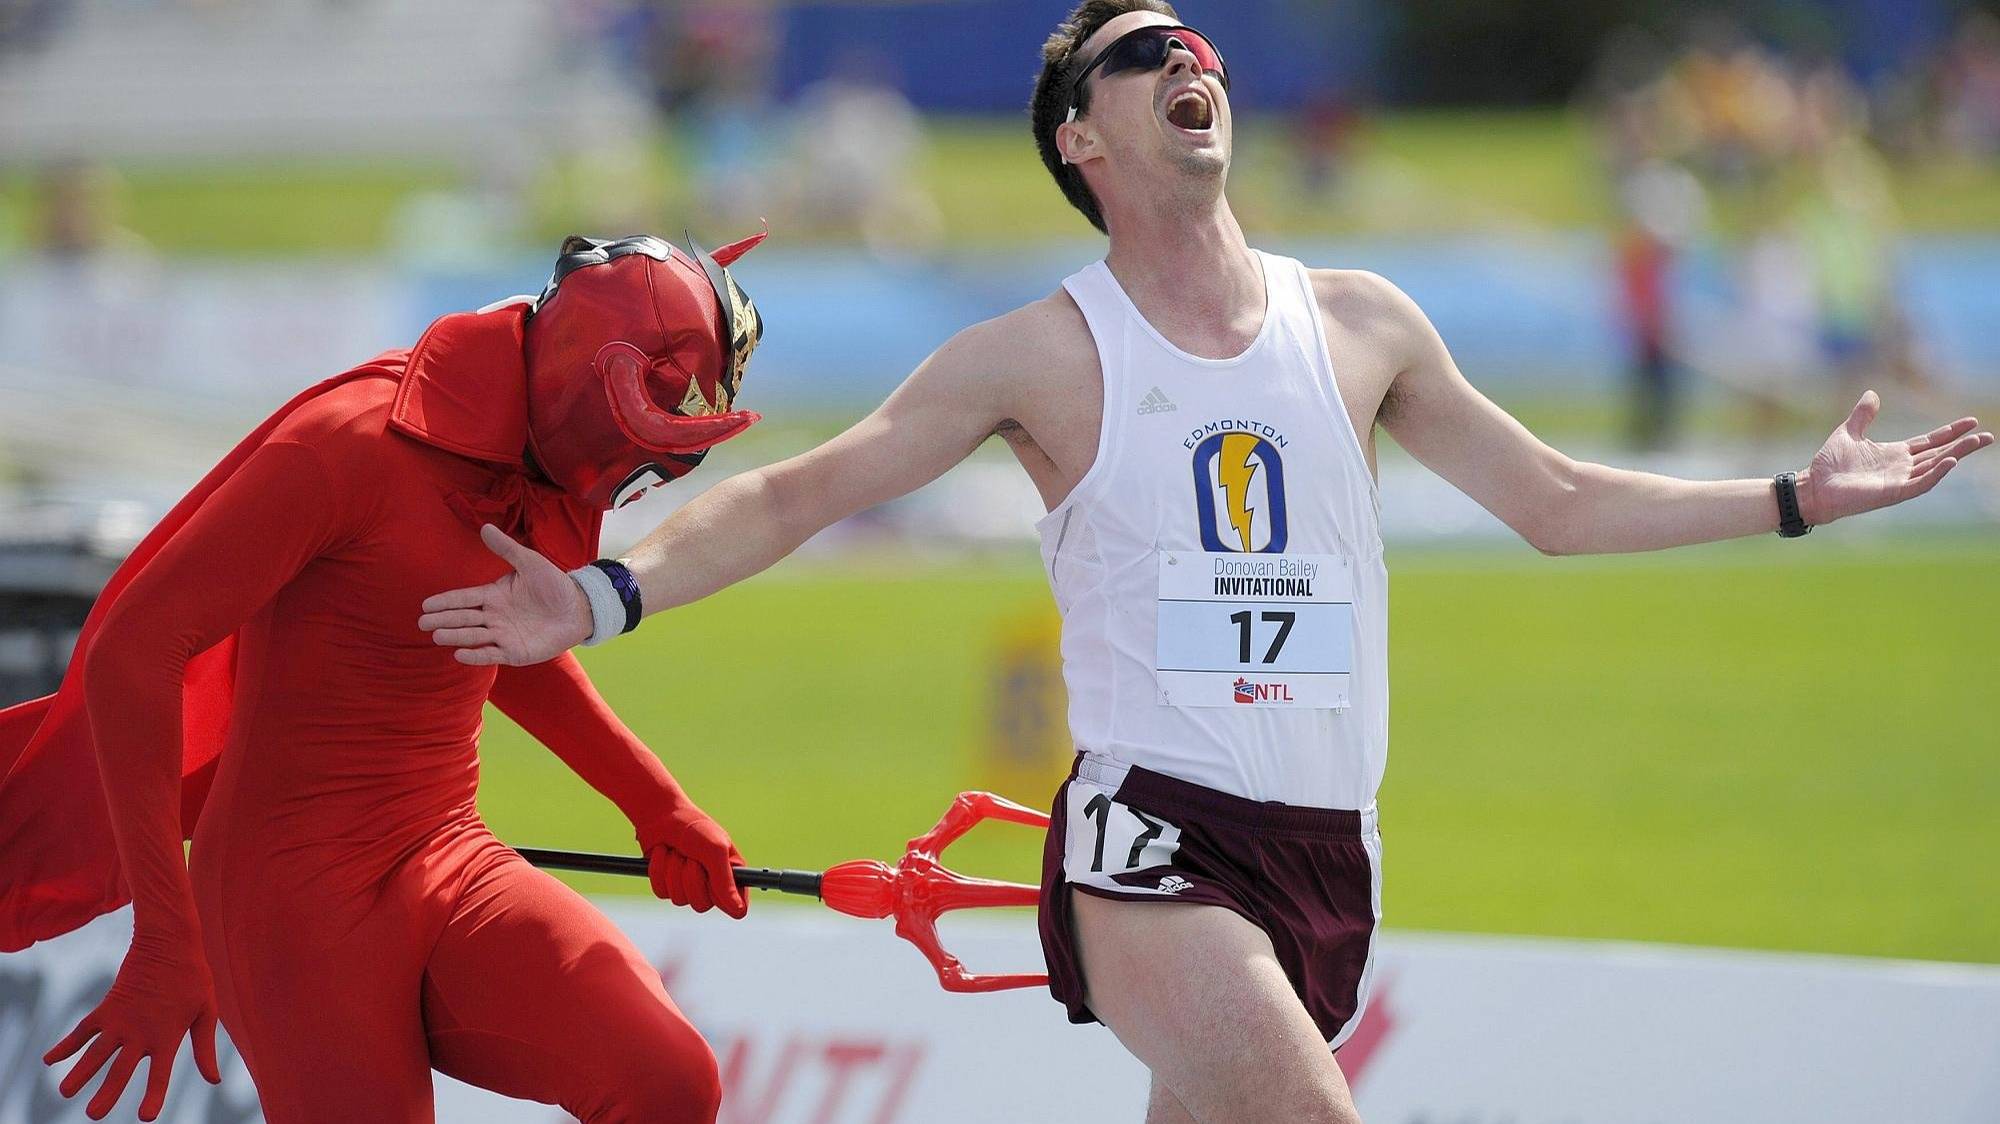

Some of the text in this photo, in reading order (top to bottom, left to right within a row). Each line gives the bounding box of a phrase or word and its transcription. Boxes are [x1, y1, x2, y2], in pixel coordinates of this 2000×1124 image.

[1137, 402, 1177, 416] adidas
[1183, 419, 1289, 450] EDMONTON
[1214, 558, 1319, 580] Donovan Bailey
[1214, 577, 1313, 597] INVITATIONAL
[1230, 610, 1296, 664] 17
[1254, 684, 1294, 701] NTL
